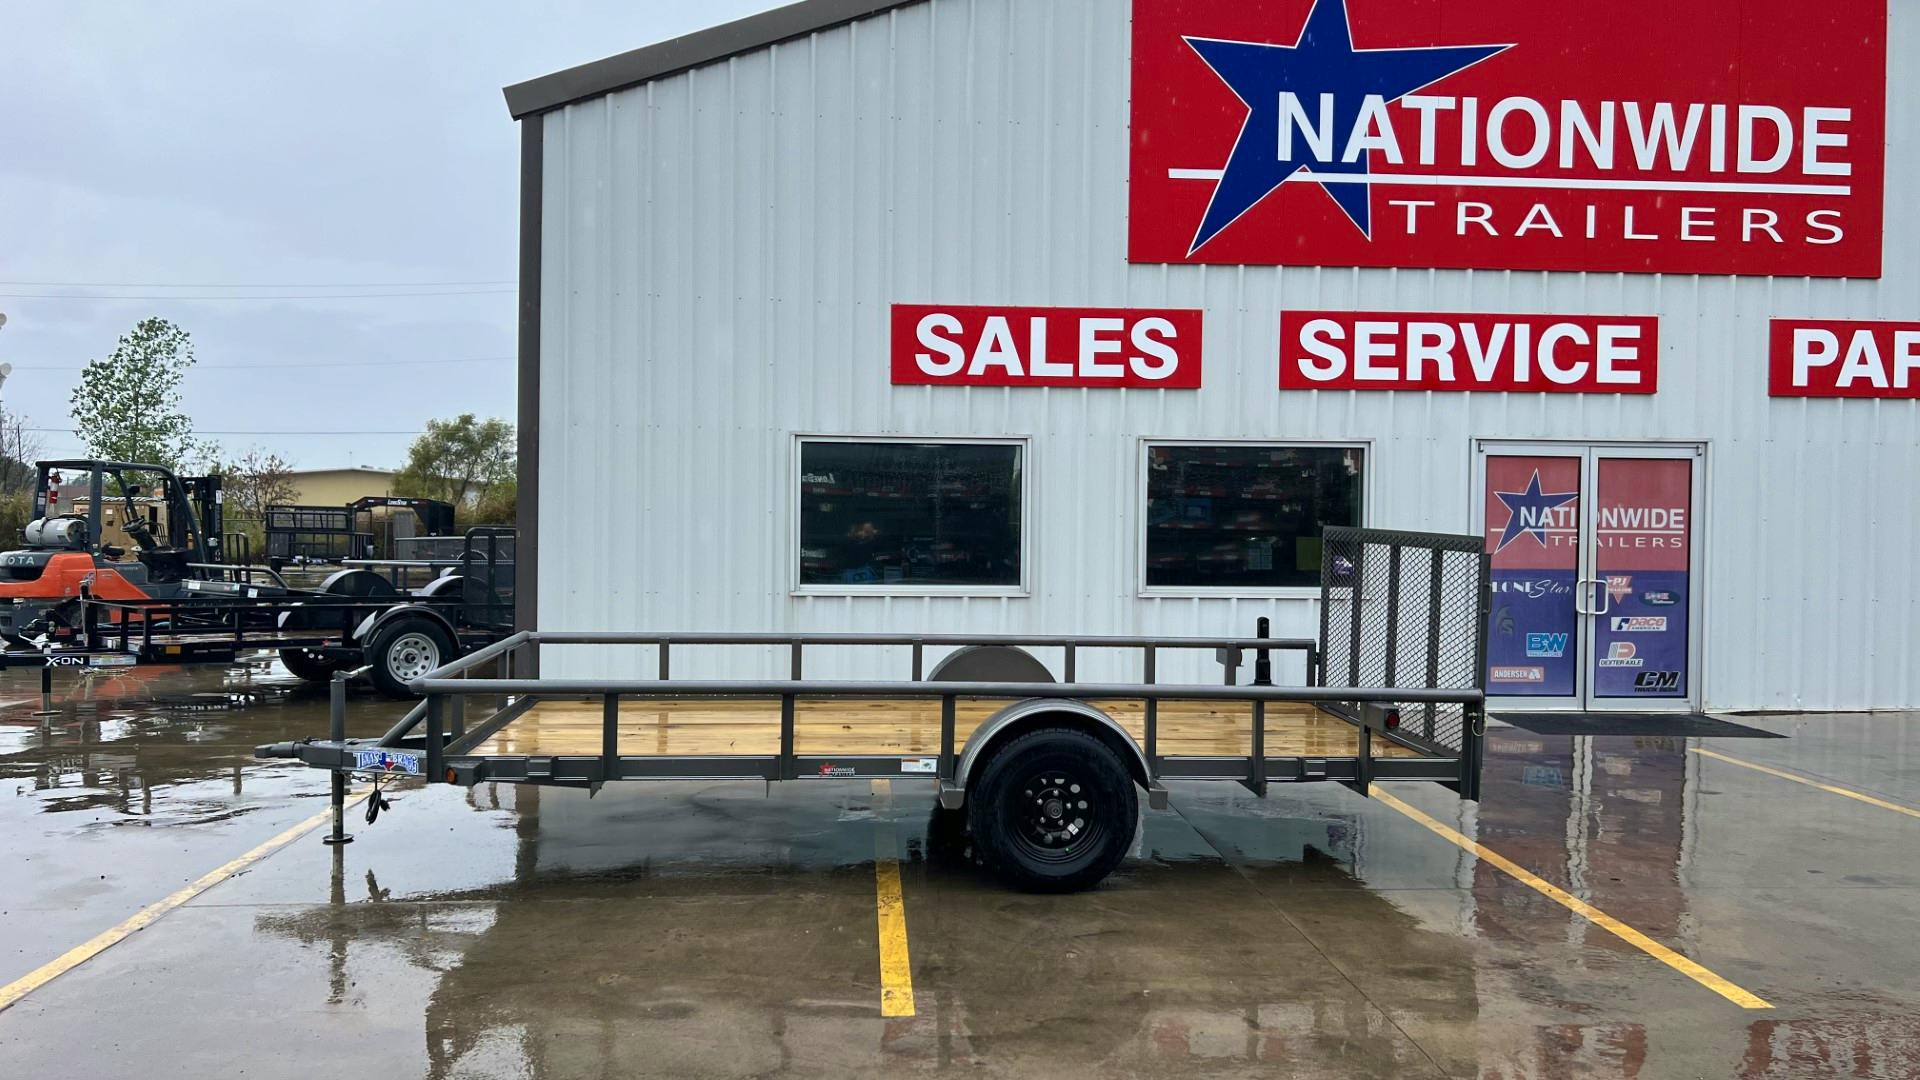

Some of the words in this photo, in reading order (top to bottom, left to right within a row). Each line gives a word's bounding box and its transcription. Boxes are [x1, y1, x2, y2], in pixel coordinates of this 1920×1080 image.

[1277, 91, 1851, 176] NATIONWIDE
[1388, 199, 1844, 244] TRAILERS
[915, 313, 1179, 380] SALES
[1297, 318, 1641, 384] SERVICE
[1520, 506, 1684, 529] NATINWIDE
[45, 656, 84, 667] X-ON
